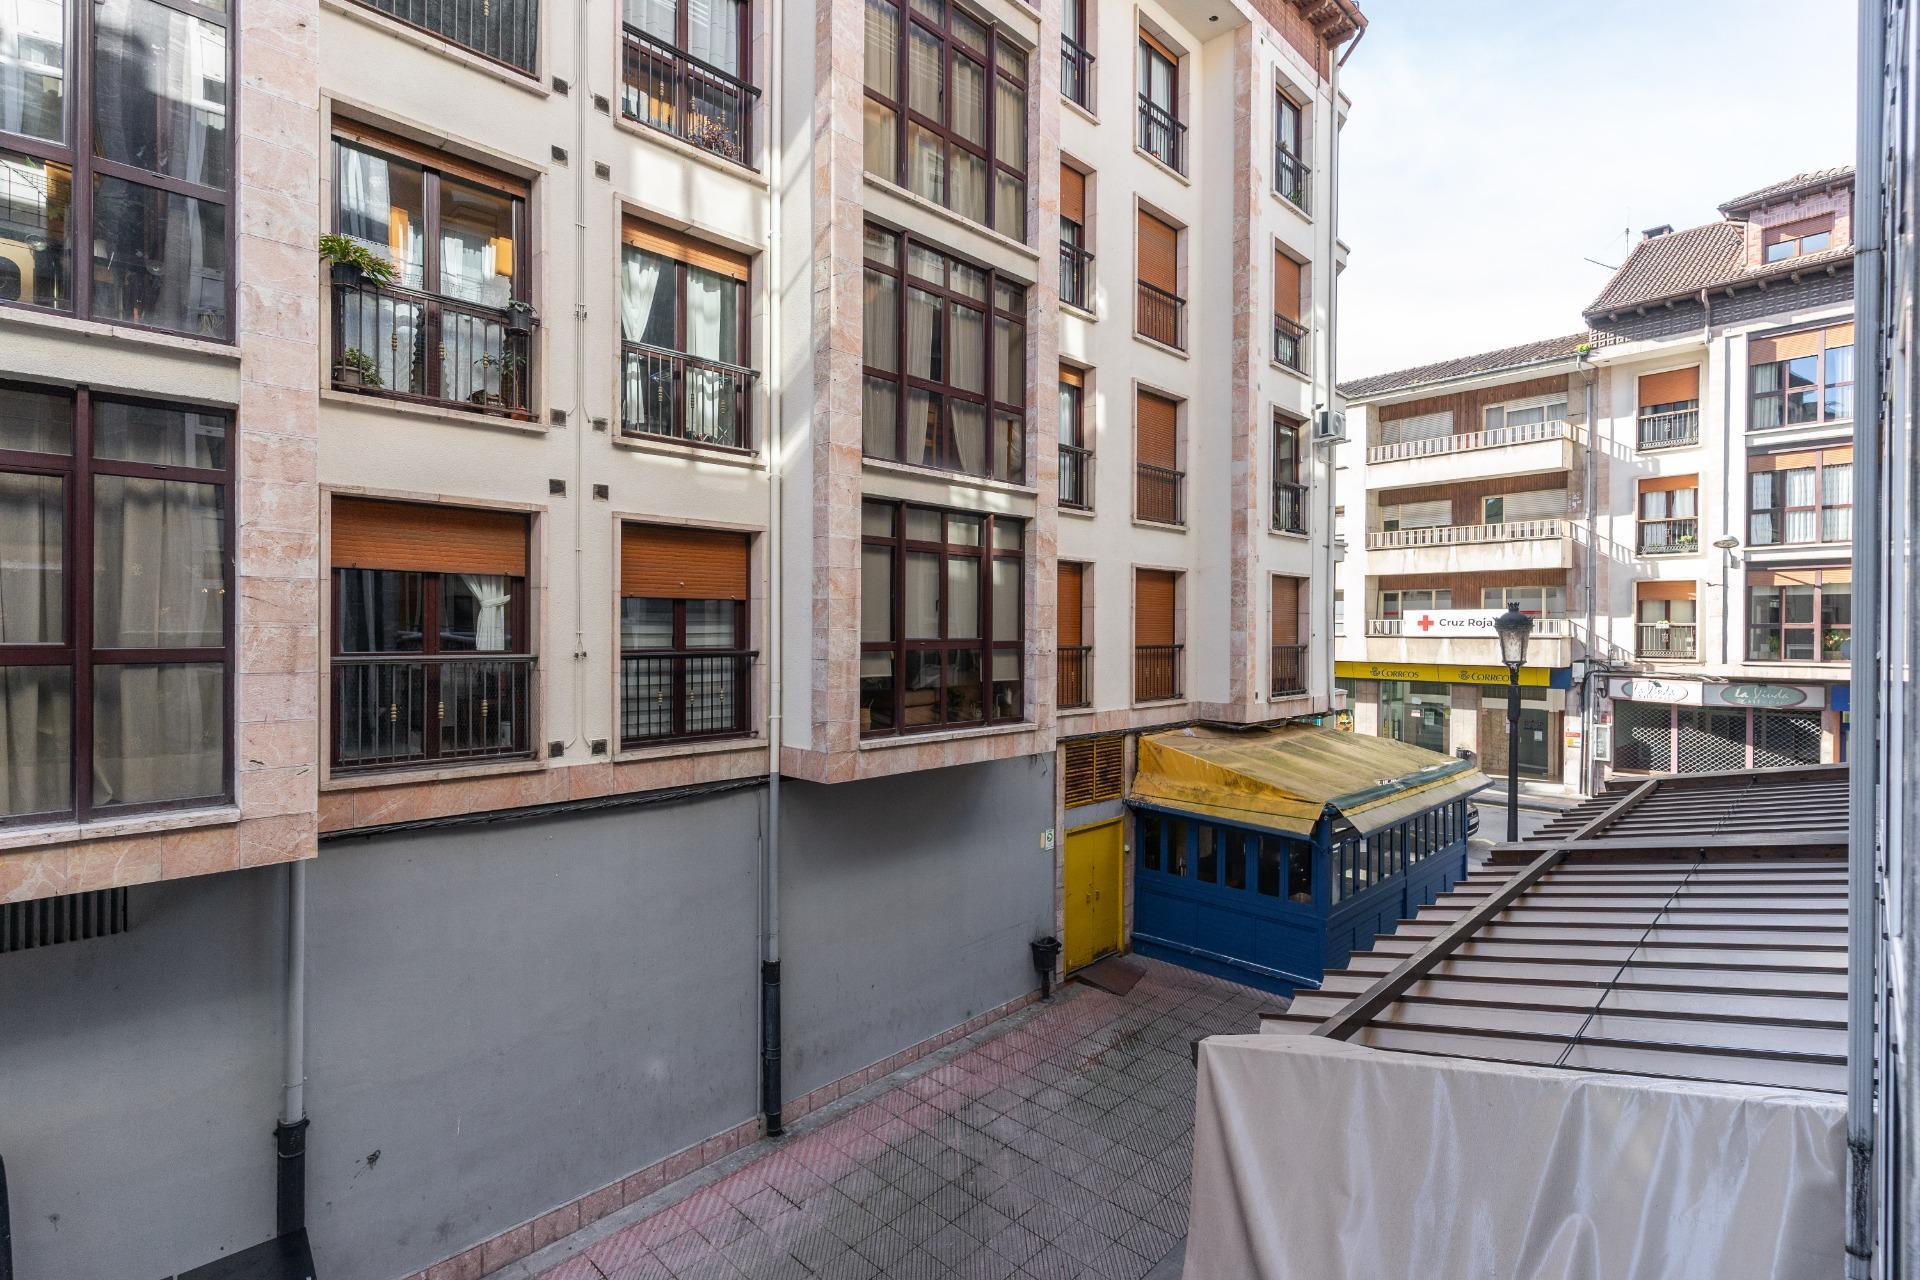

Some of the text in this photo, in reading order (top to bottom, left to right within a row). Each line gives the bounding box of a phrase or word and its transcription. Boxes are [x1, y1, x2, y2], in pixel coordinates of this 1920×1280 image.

[1439, 617, 1493, 629] Cruz Roja
[1381, 669, 1419, 678] CORREOS
[1471, 672, 1511, 682] CORREO
[1734, 687, 1749, 698] La
